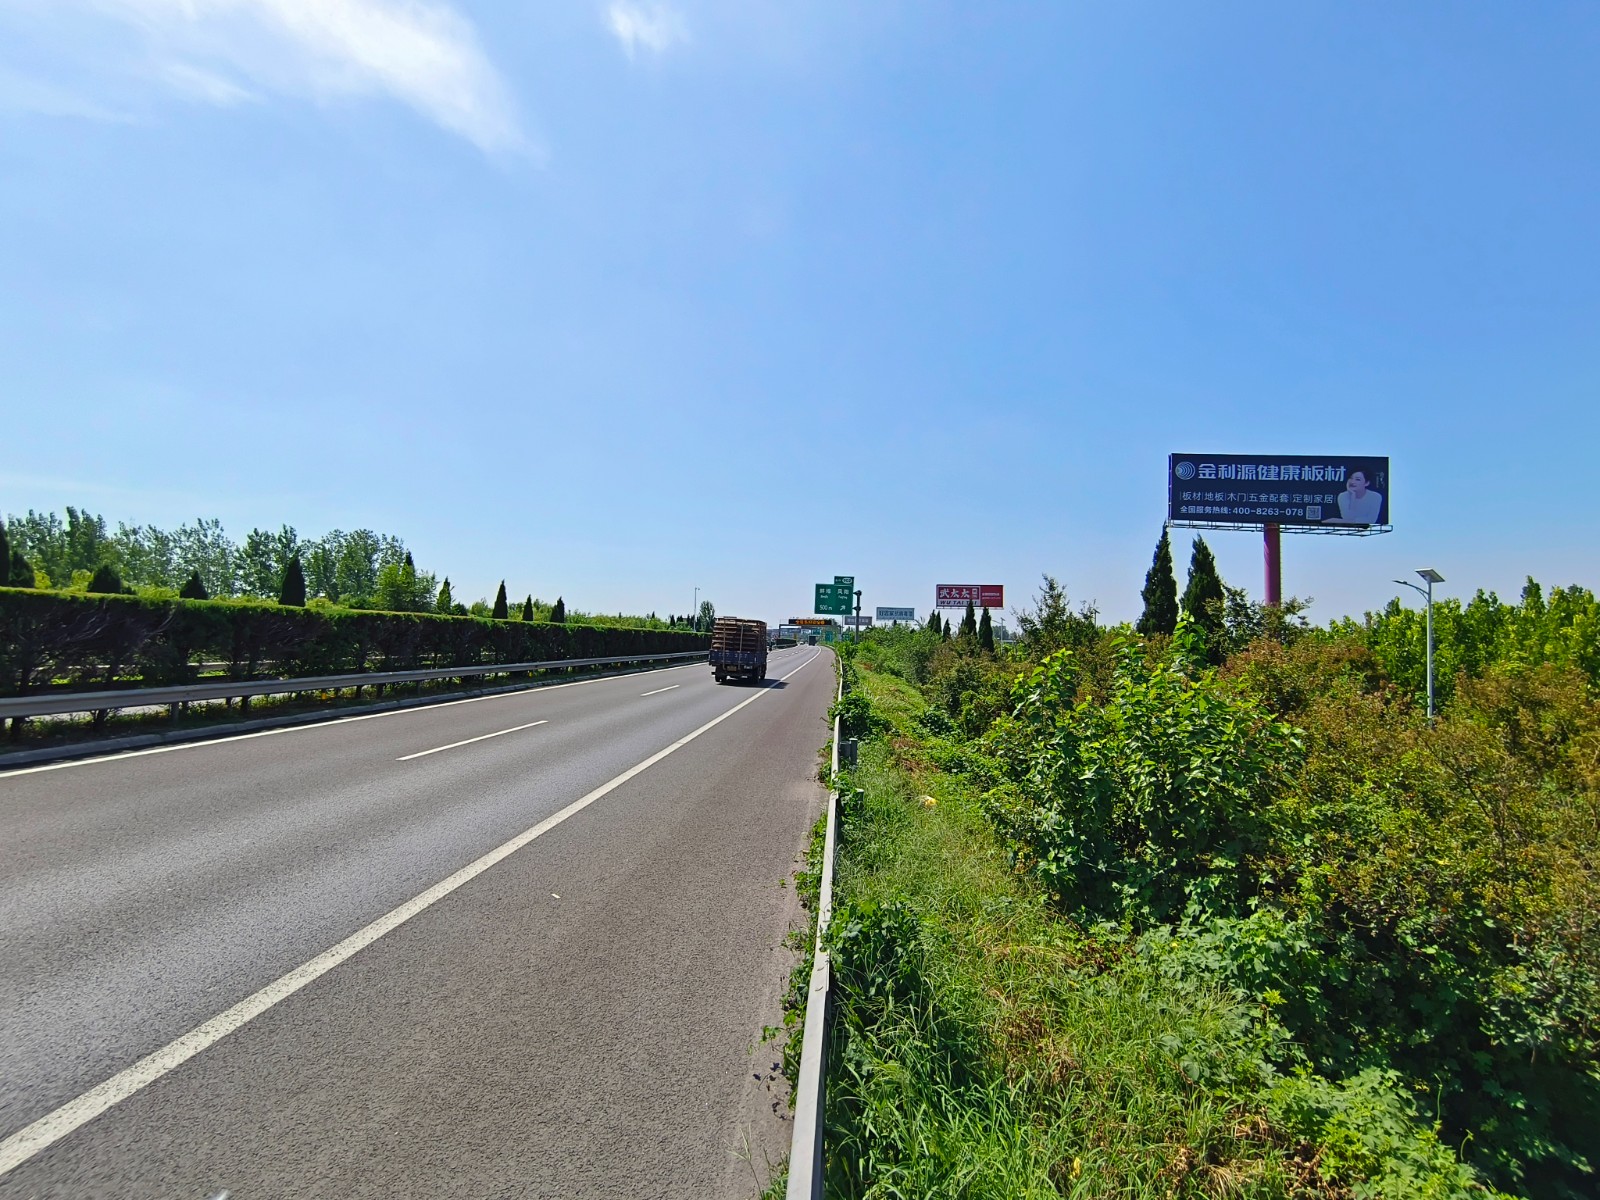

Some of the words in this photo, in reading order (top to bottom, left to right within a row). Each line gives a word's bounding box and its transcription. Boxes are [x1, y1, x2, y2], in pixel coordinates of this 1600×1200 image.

[1198, 463, 1347, 482] 金利源健康板材
[939, 587, 970, 598] 武太太
